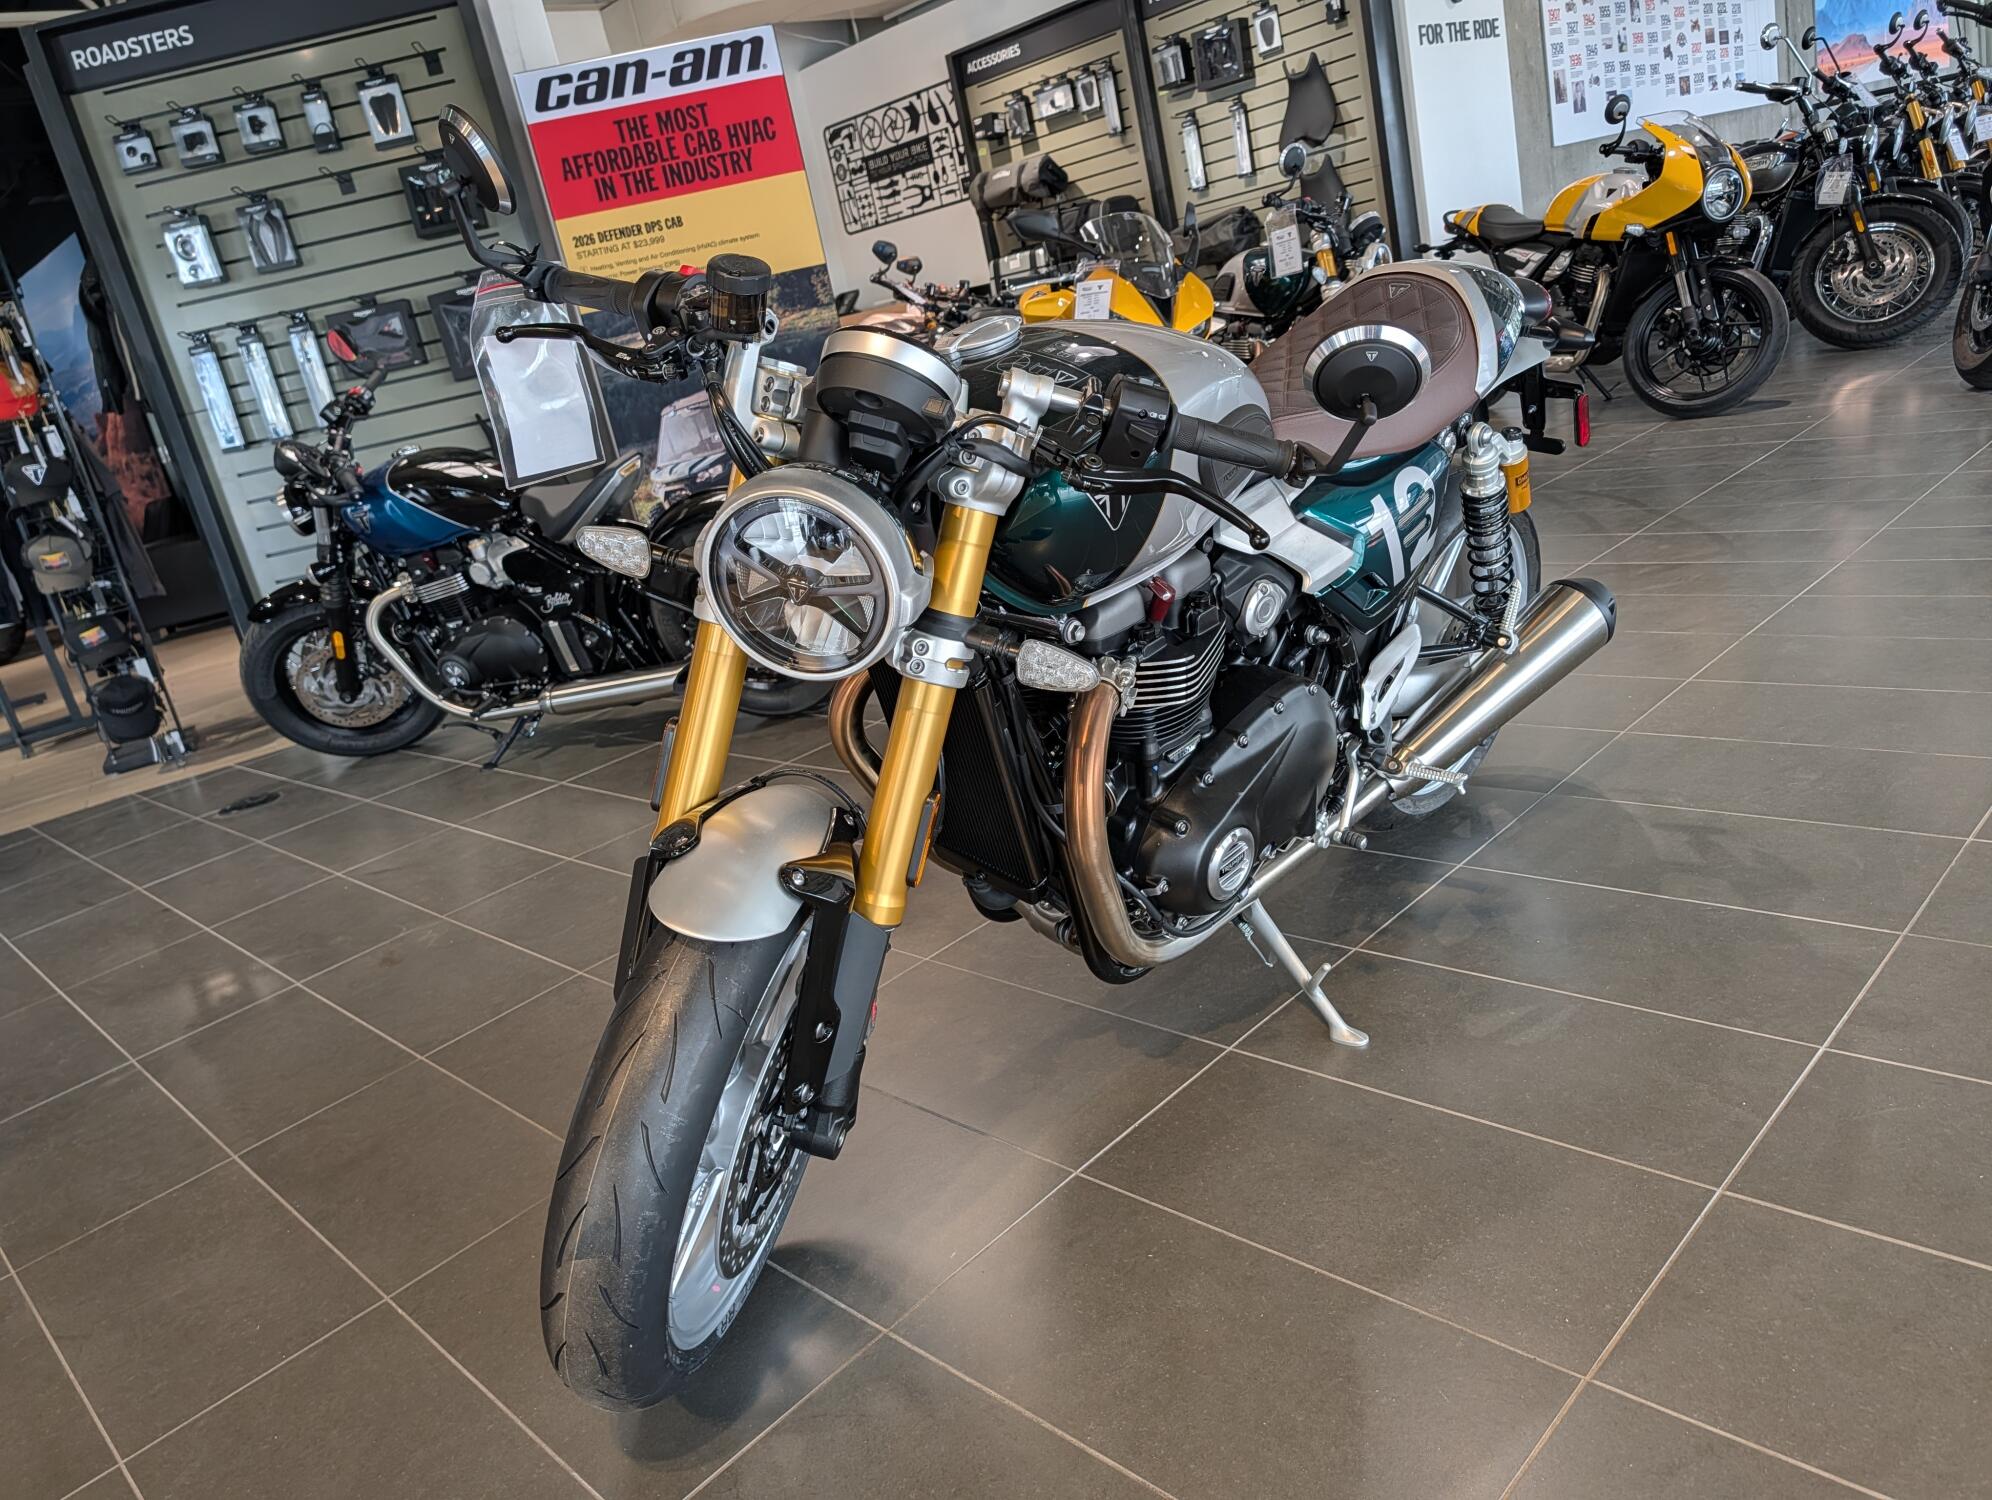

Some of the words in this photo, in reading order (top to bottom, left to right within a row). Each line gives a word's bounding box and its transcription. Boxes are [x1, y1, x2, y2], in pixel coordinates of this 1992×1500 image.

[71, 25, 194, 71] ROADSTERS
[1418, 23, 1444, 46] FOR
[1445, 20, 1471, 43] THE
[1473, 17, 1501, 40] RIDE
[535, 35, 765, 113] can-am
[966, 43, 1021, 75] ACCESSORIES
[613, 114, 653, 144] THE
[655, 103, 710, 136] MOST
[561, 136, 680, 182] AFFORDABLE
[683, 128, 722, 157] CAB
[726, 116, 776, 149] HVAC
[868, 154, 889, 170] BUILD
[889, 147, 910, 161] YOUR
[911, 141, 928, 155] BIKE
[594, 176, 618, 202] IN
[621, 168, 659, 196] THE
[662, 147, 753, 189] INDUSTRY
[572, 233, 596, 249] 2026
[597, 223, 643, 244] DEFENDER
[644, 219, 664, 234] DPS
[664, 215, 684, 230] CAB
[576, 245, 620, 260] STARTING
[620, 241, 633, 252] AT
[638, 255, 650, 263] and
